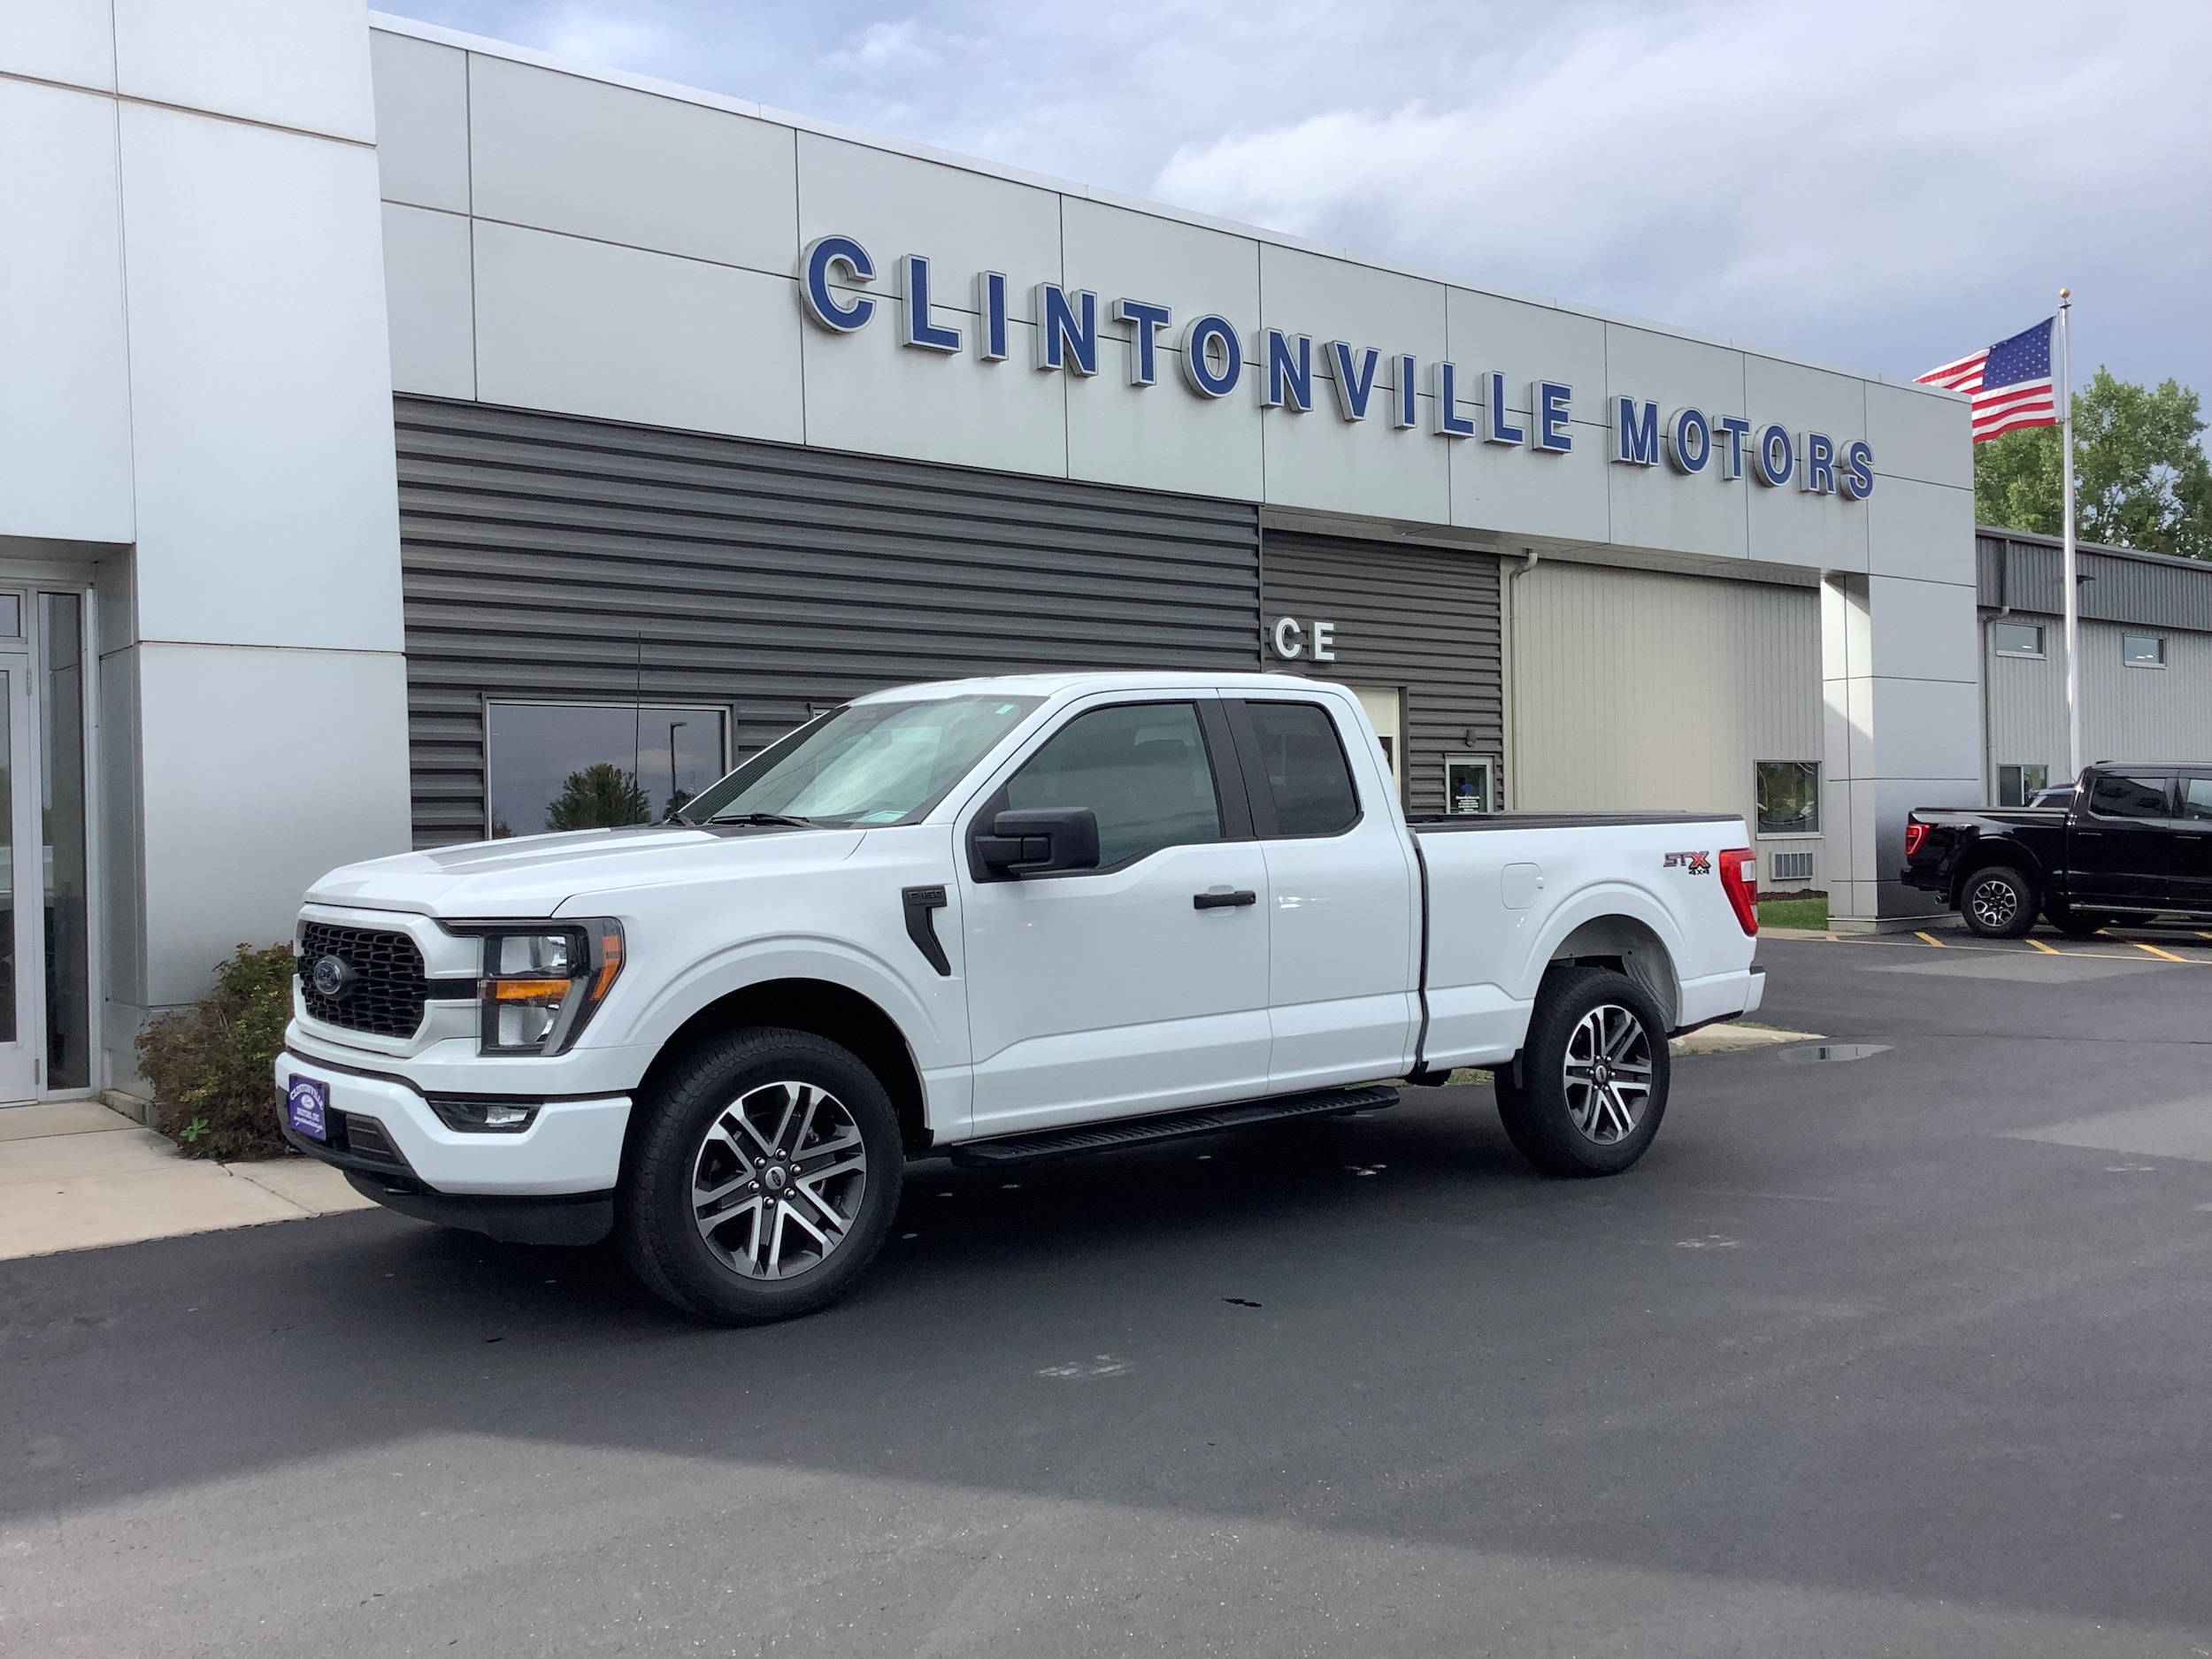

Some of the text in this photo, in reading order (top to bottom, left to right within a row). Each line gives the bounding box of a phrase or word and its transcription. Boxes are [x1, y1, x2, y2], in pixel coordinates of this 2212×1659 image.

[800, 234, 1874, 501] CLINTONVILLE MOTORS
[1271, 617, 1336, 661] CE
[1663, 851, 1711, 869] STX
[908, 889, 943, 899] F-150
